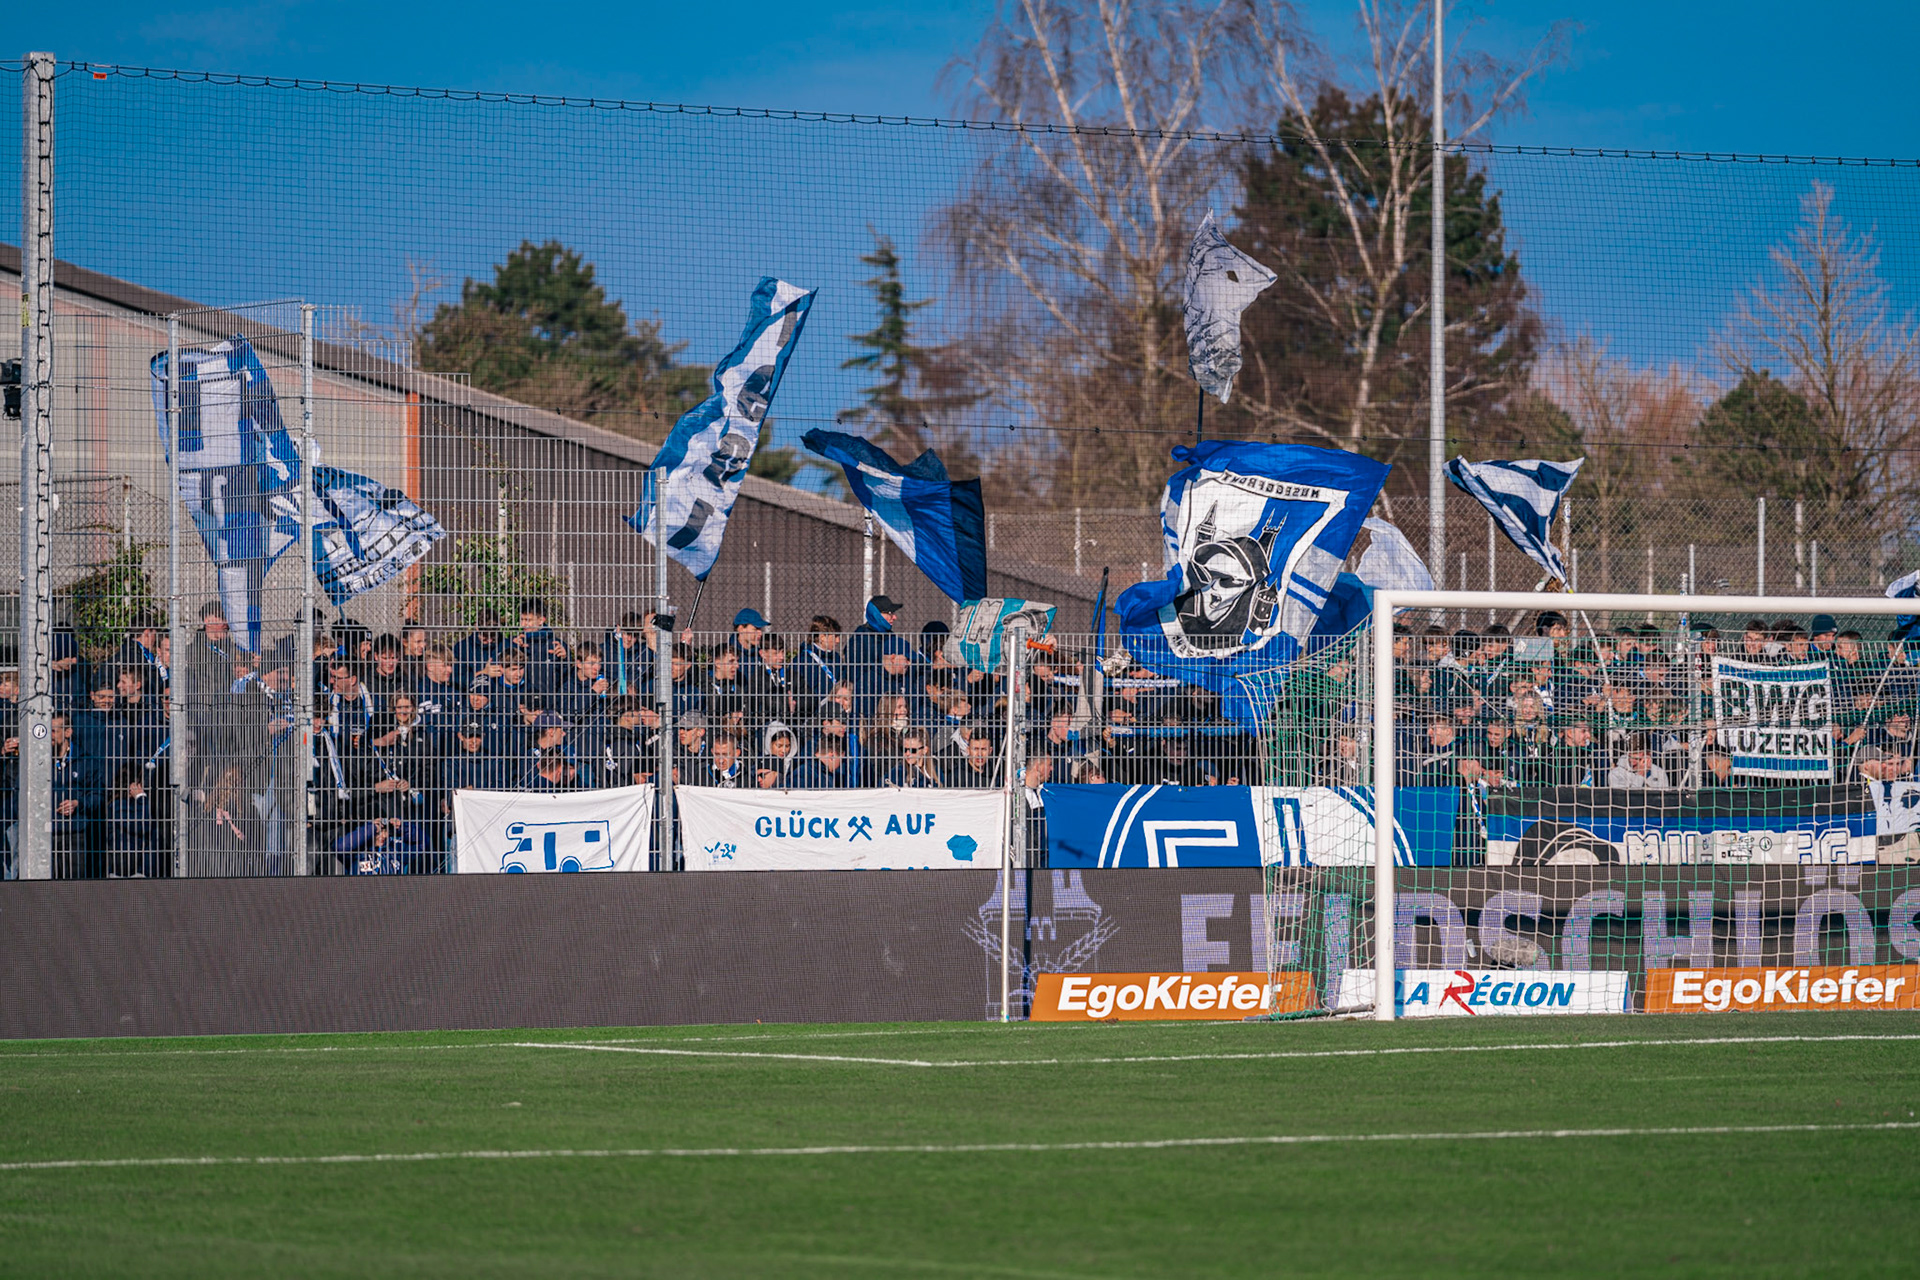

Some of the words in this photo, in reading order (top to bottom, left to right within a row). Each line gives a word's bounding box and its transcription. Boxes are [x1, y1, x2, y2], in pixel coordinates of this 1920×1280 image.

[1720, 680, 1828, 729] BWG
[1722, 730, 1828, 755] LUZERN
[755, 810, 840, 838] GLÜCK
[884, 813, 936, 835] AUF
[1058, 976, 1282, 1018] EgoKiefer
[1438, 970, 1575, 1016] RÉGION
[1672, 969, 1905, 1011] EgoKiefer
